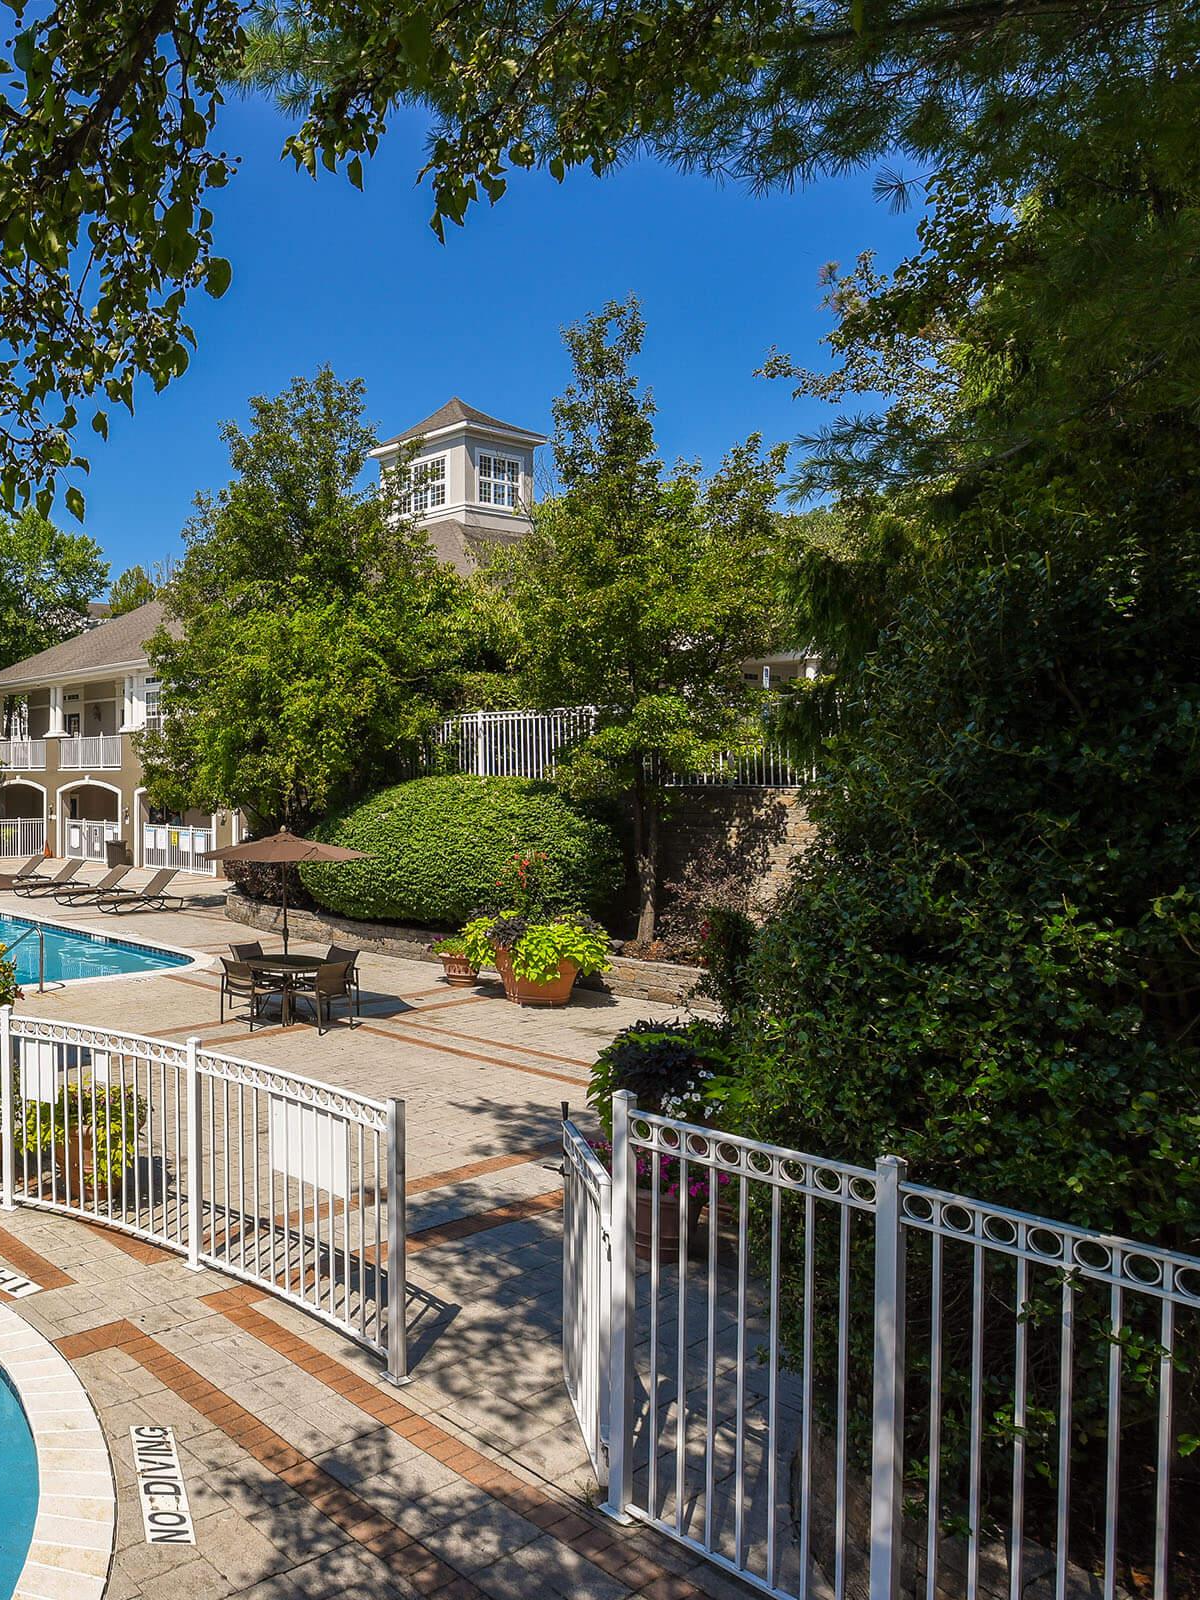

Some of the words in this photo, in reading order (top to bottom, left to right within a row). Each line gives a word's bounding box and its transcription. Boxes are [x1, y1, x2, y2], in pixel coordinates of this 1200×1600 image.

[8, 1282, 30, 1292] 1
[134, 1426, 182, 1495] DIVING
[148, 1512, 192, 1543] NO
